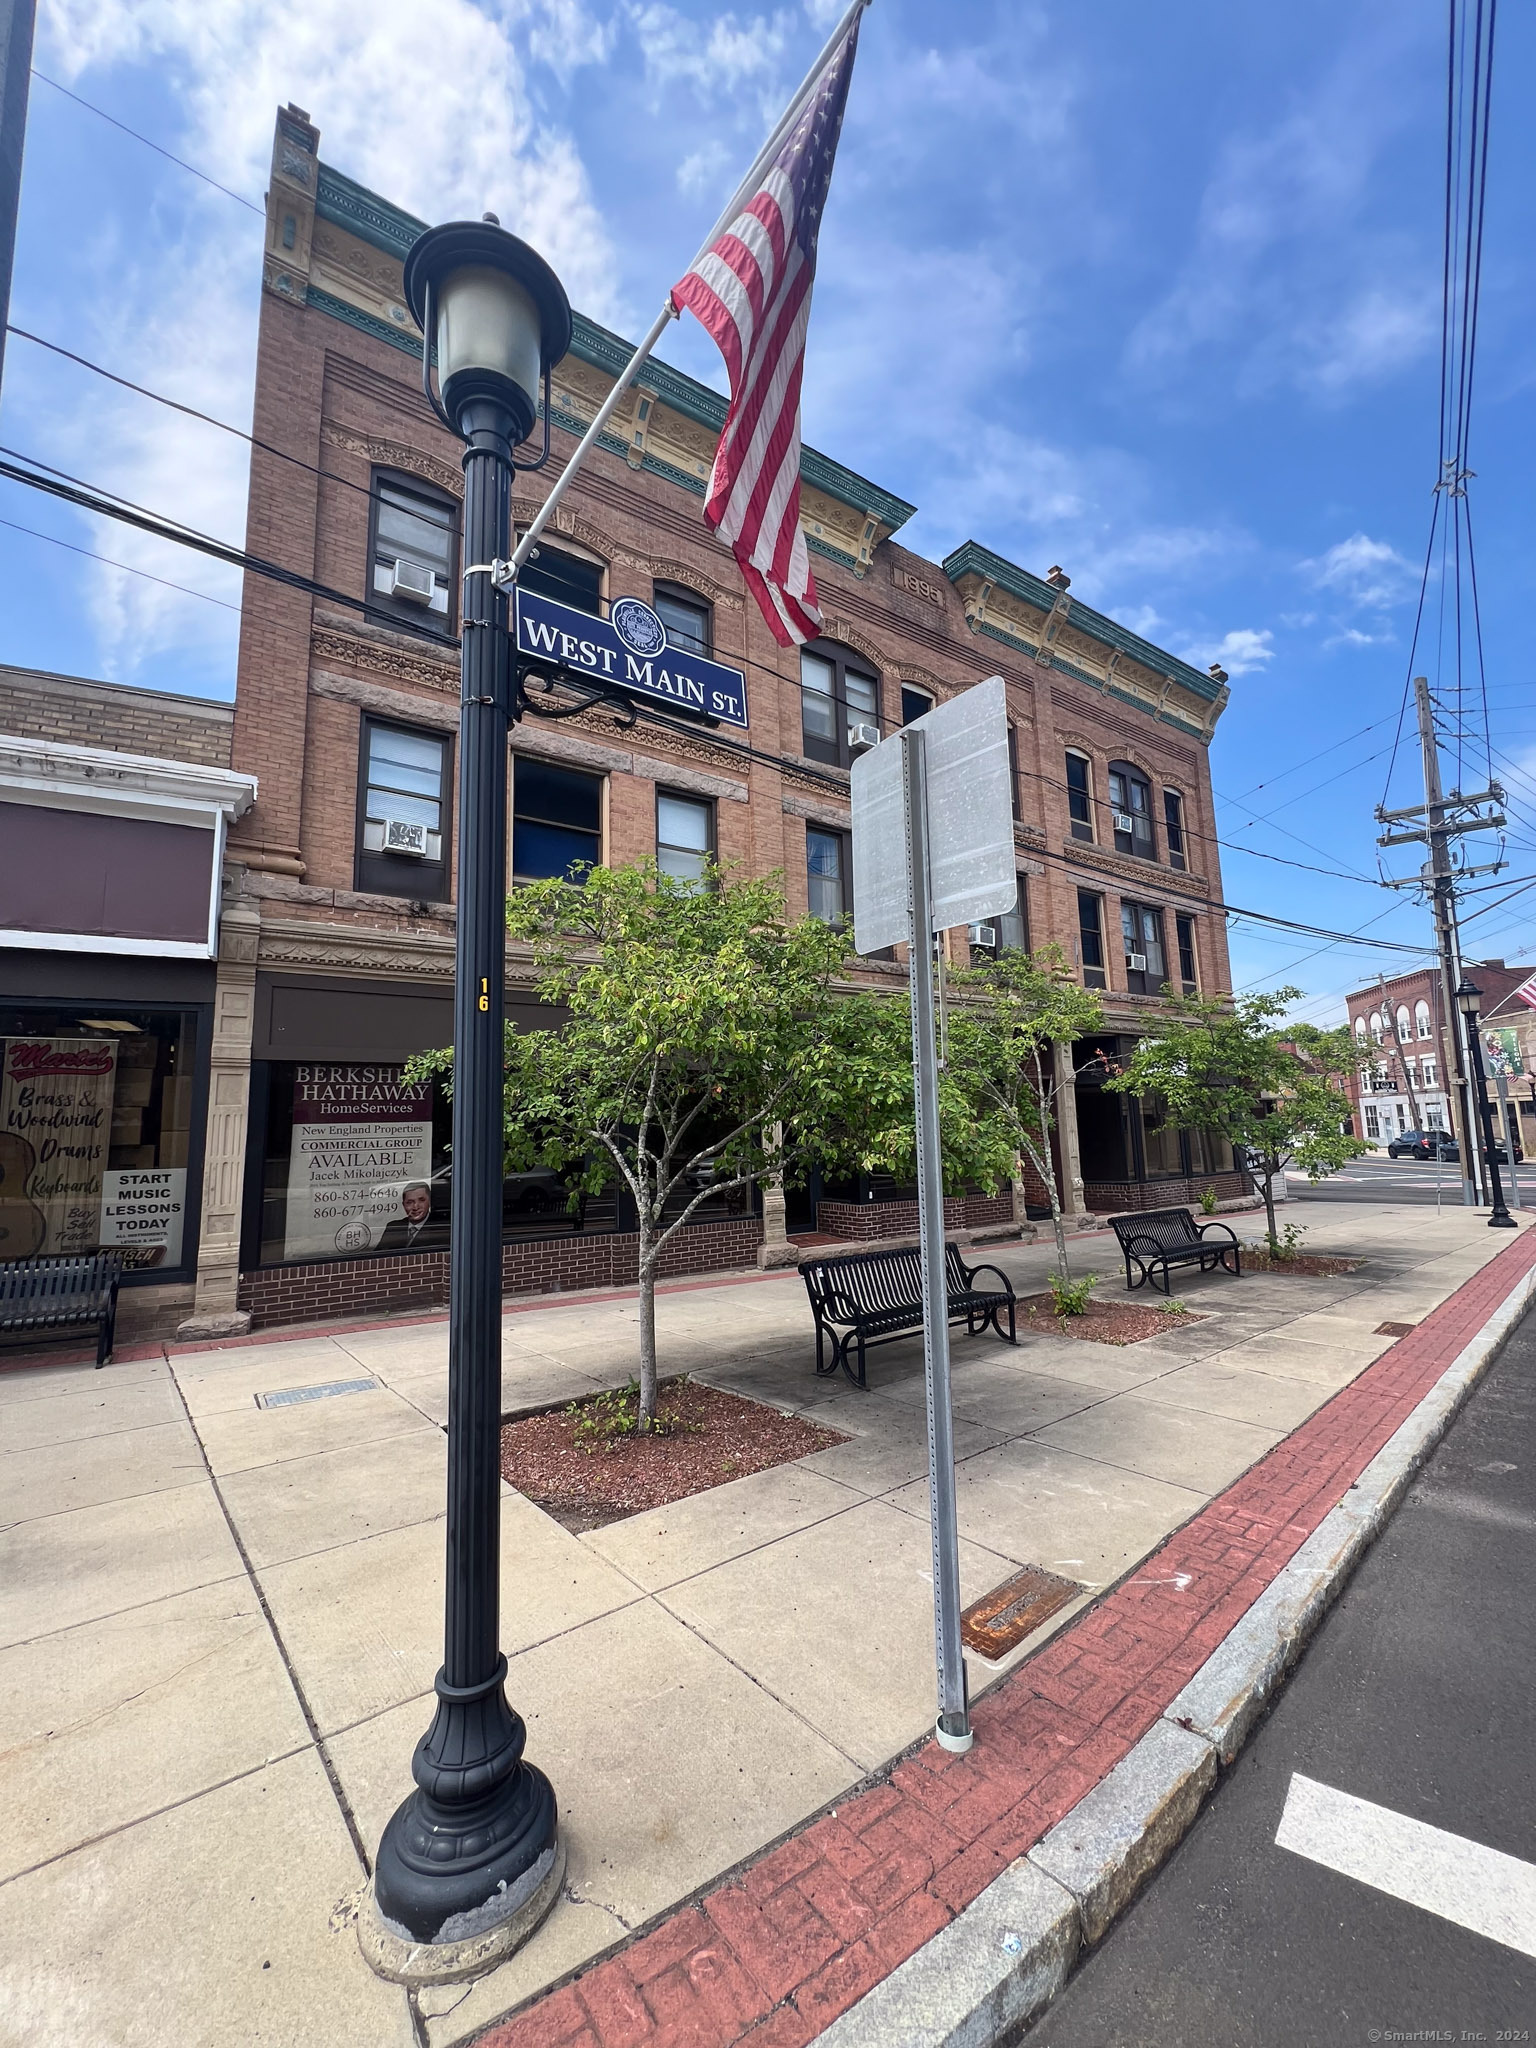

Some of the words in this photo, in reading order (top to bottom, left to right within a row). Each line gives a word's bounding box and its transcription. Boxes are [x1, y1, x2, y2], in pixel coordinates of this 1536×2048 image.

[903, 573, 939, 602] 1895
[522, 616, 617, 674] WEST
[625, 654, 705, 705] MAIN
[712, 691, 742, 718] ST.
[1509, 1032, 1520, 1067] WELCOME
[296, 1066, 432, 1084] BERKSHI
[19, 1087, 75, 1108] Brass
[79, 1090, 97, 1107] &
[301, 1084, 430, 1101] HATHAWAY
[320, 1102, 413, 1114] HomeServices
[8, 1108, 104, 1129] Woodwind
[302, 1126, 326, 1136] New
[329, 1125, 371, 1137] England
[374, 1124, 423, 1135] Properties
[40, 1139, 104, 1164] Drums
[301, 1140, 383, 1151] COMMERCIAL
[385, 1139, 423, 1148] GROUP
[308, 1151, 414, 1169] AVAILABLE
[119, 1174, 172, 1185] START
[309, 1170, 340, 1181] Jacek
[343, 1167, 408, 1180] Mikolajczyk
[30, 1174, 101, 1203] Keyboards
[118, 1189, 171, 1200] MUSIC
[314, 1188, 399, 1203] 860-874-6646
[67, 1207, 96, 1219] Buy
[106, 1203, 181, 1216] LESSONS
[313, 1203, 398, 1218] 860-677-4949
[66, 1219, 96, 1230] Sell
[115, 1218, 170, 1231] TODAY
[55, 1230, 94, 1241] Trade
[346, 1230, 361, 1239] BH
[345, 1238, 360, 1247] HS
